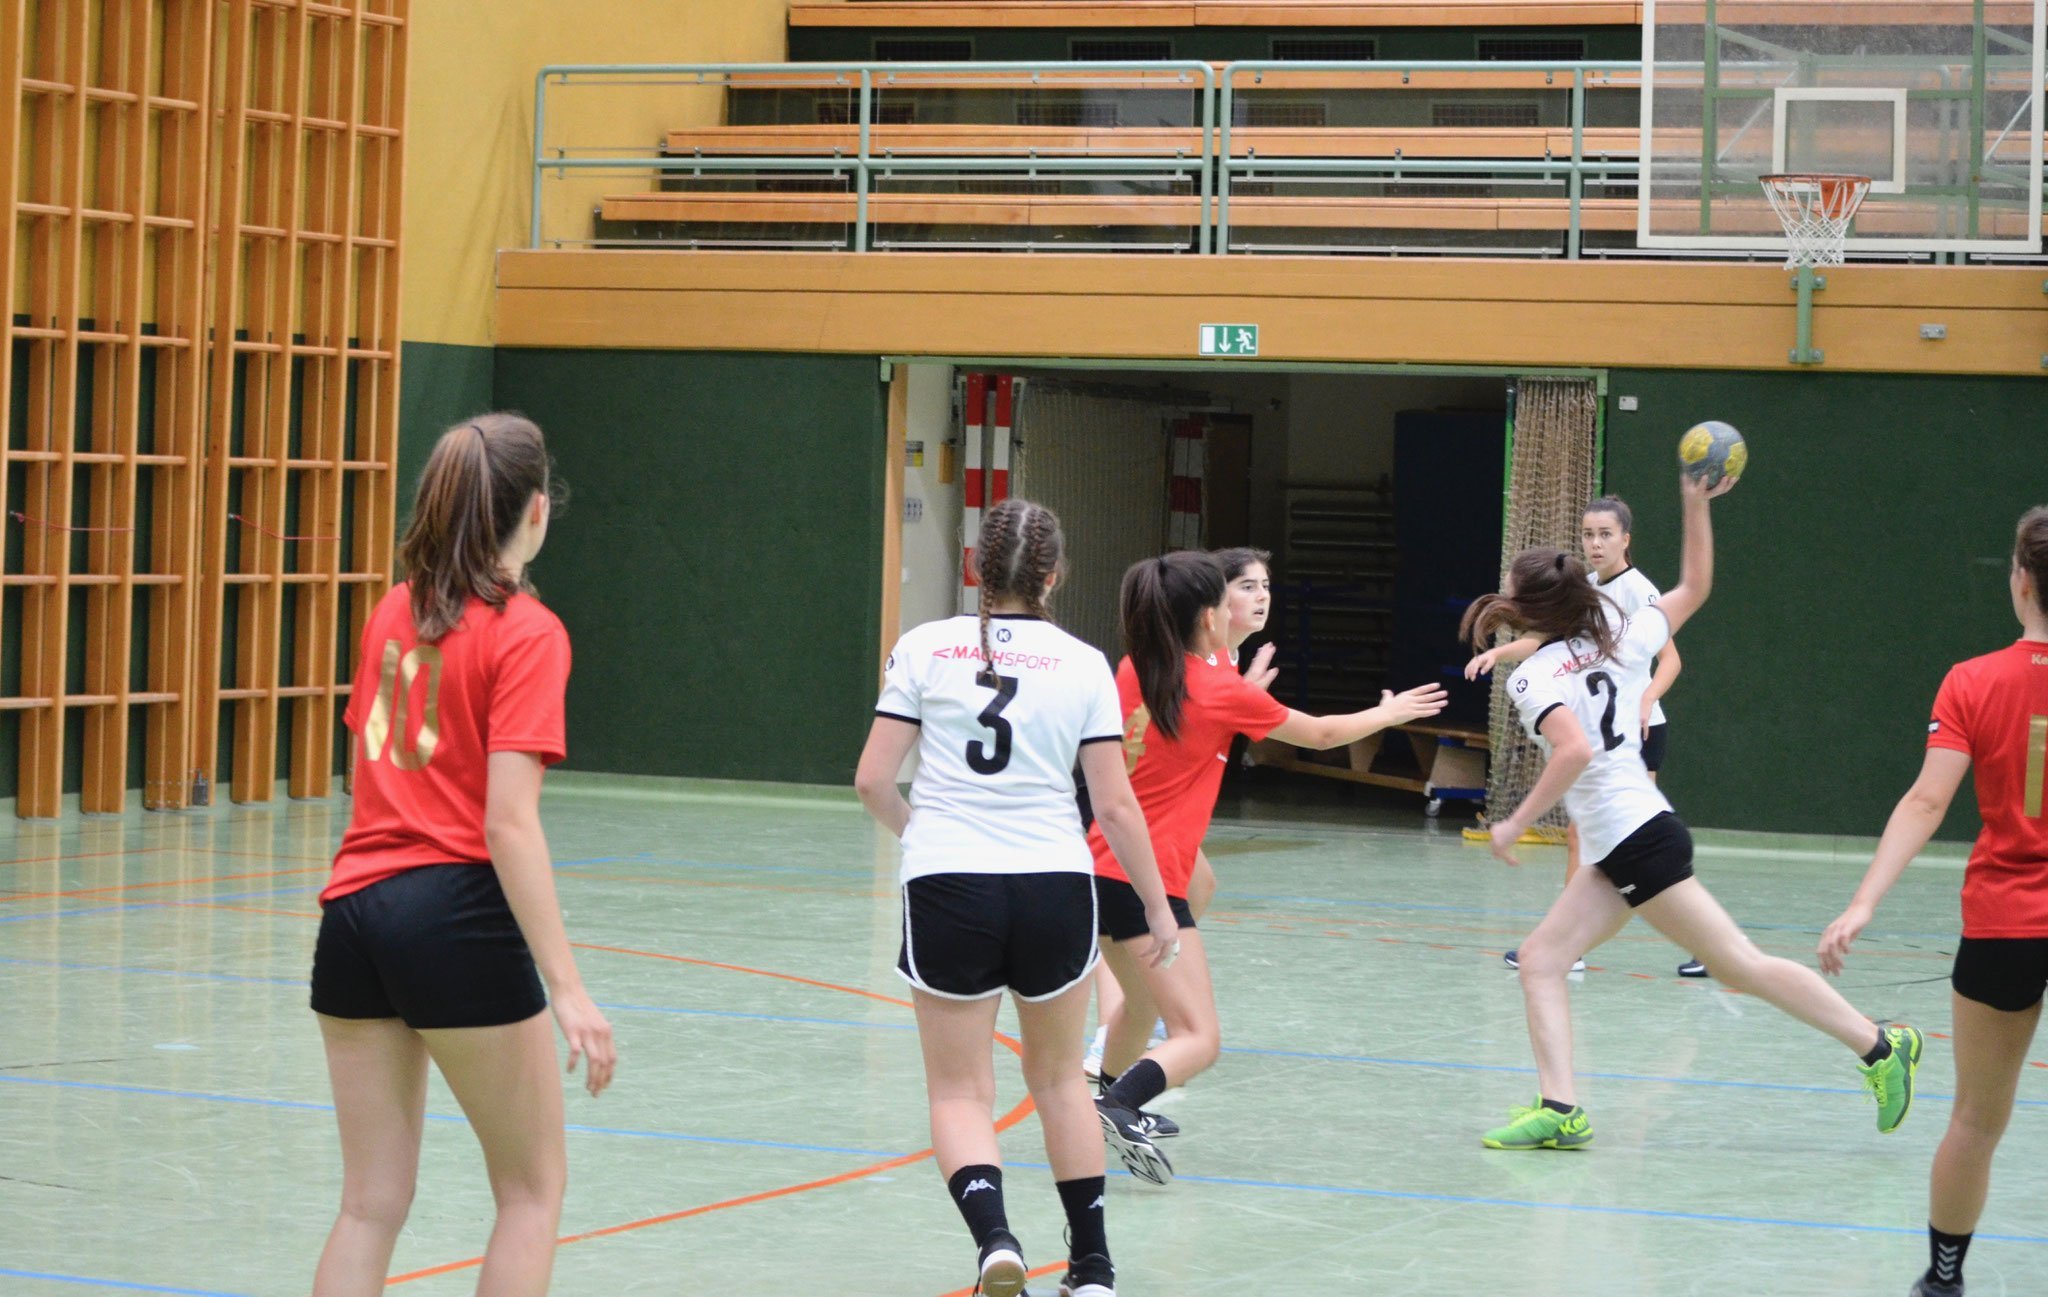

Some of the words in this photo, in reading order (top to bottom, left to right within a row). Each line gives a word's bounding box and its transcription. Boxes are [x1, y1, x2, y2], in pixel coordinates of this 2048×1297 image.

[364, 639, 444, 771] 10
[966, 671, 1018, 775] 3
[1586, 671, 1625, 751] 2
